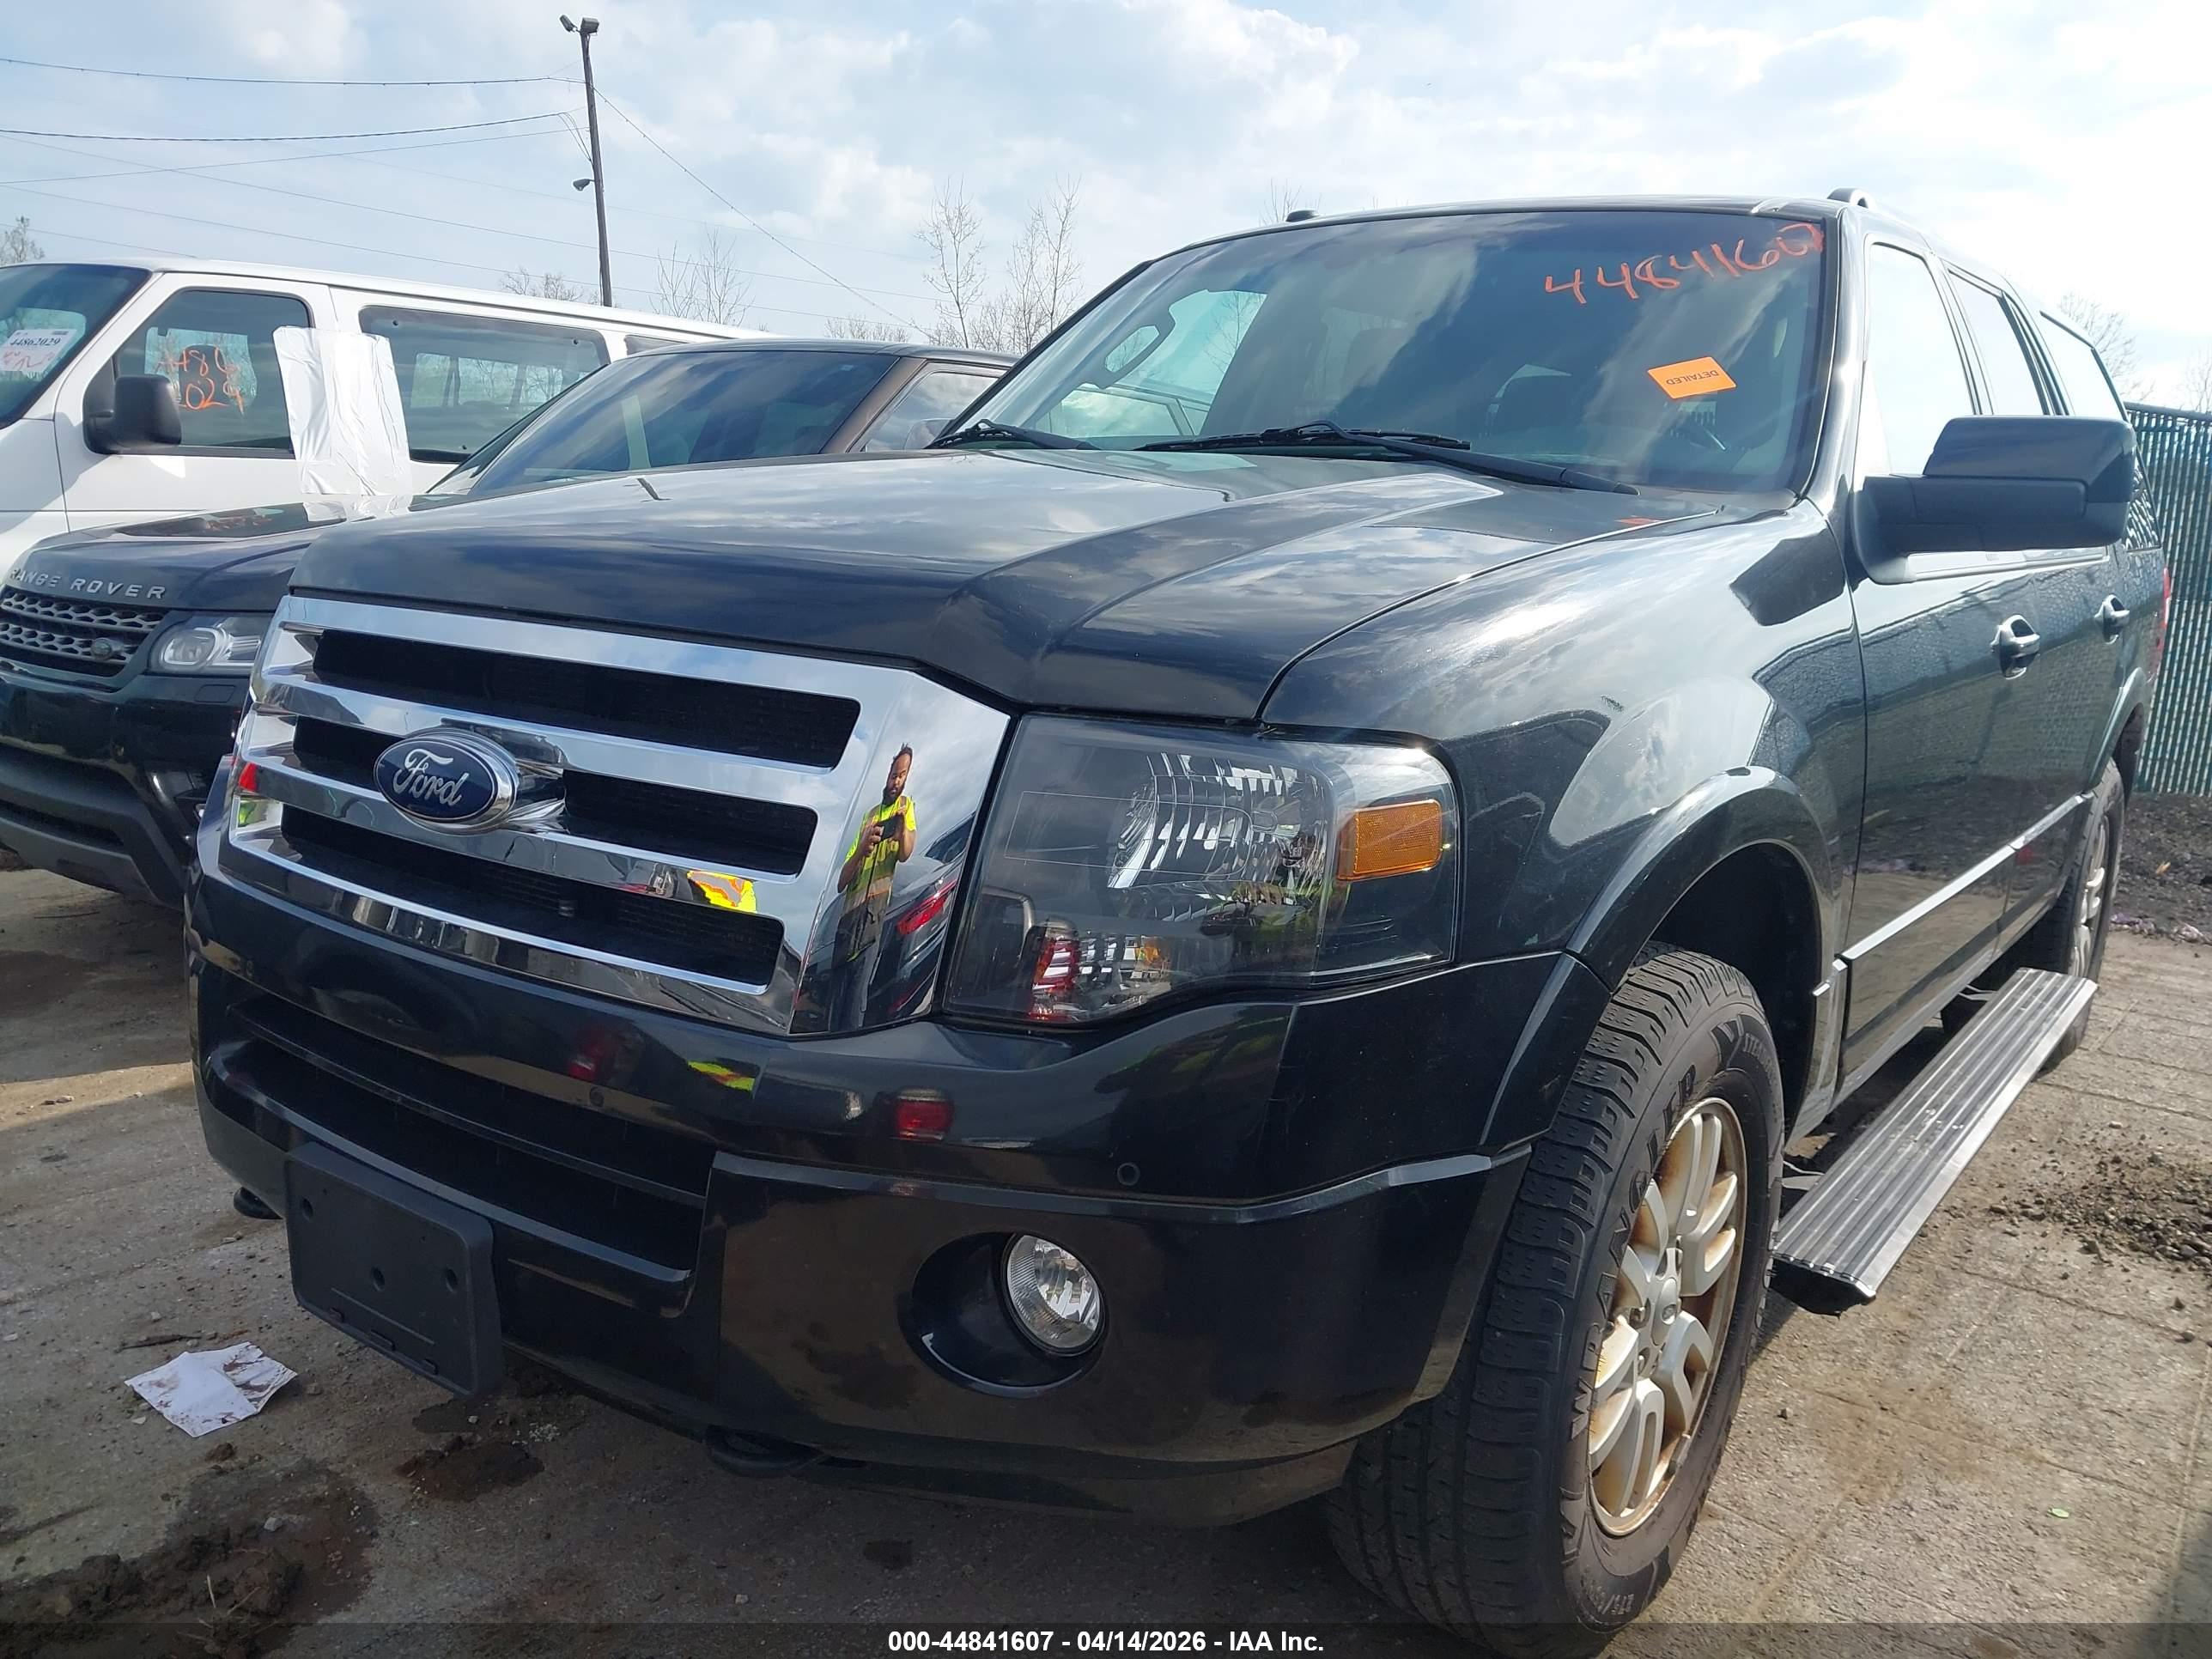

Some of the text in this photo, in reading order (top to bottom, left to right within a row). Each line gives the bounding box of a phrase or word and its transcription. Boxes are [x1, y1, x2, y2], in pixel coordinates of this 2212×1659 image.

[1665, 368, 1720, 386] DETAILED
[9, 567, 166, 600] RANGE ROVER
[392, 748, 470, 806] Ford
